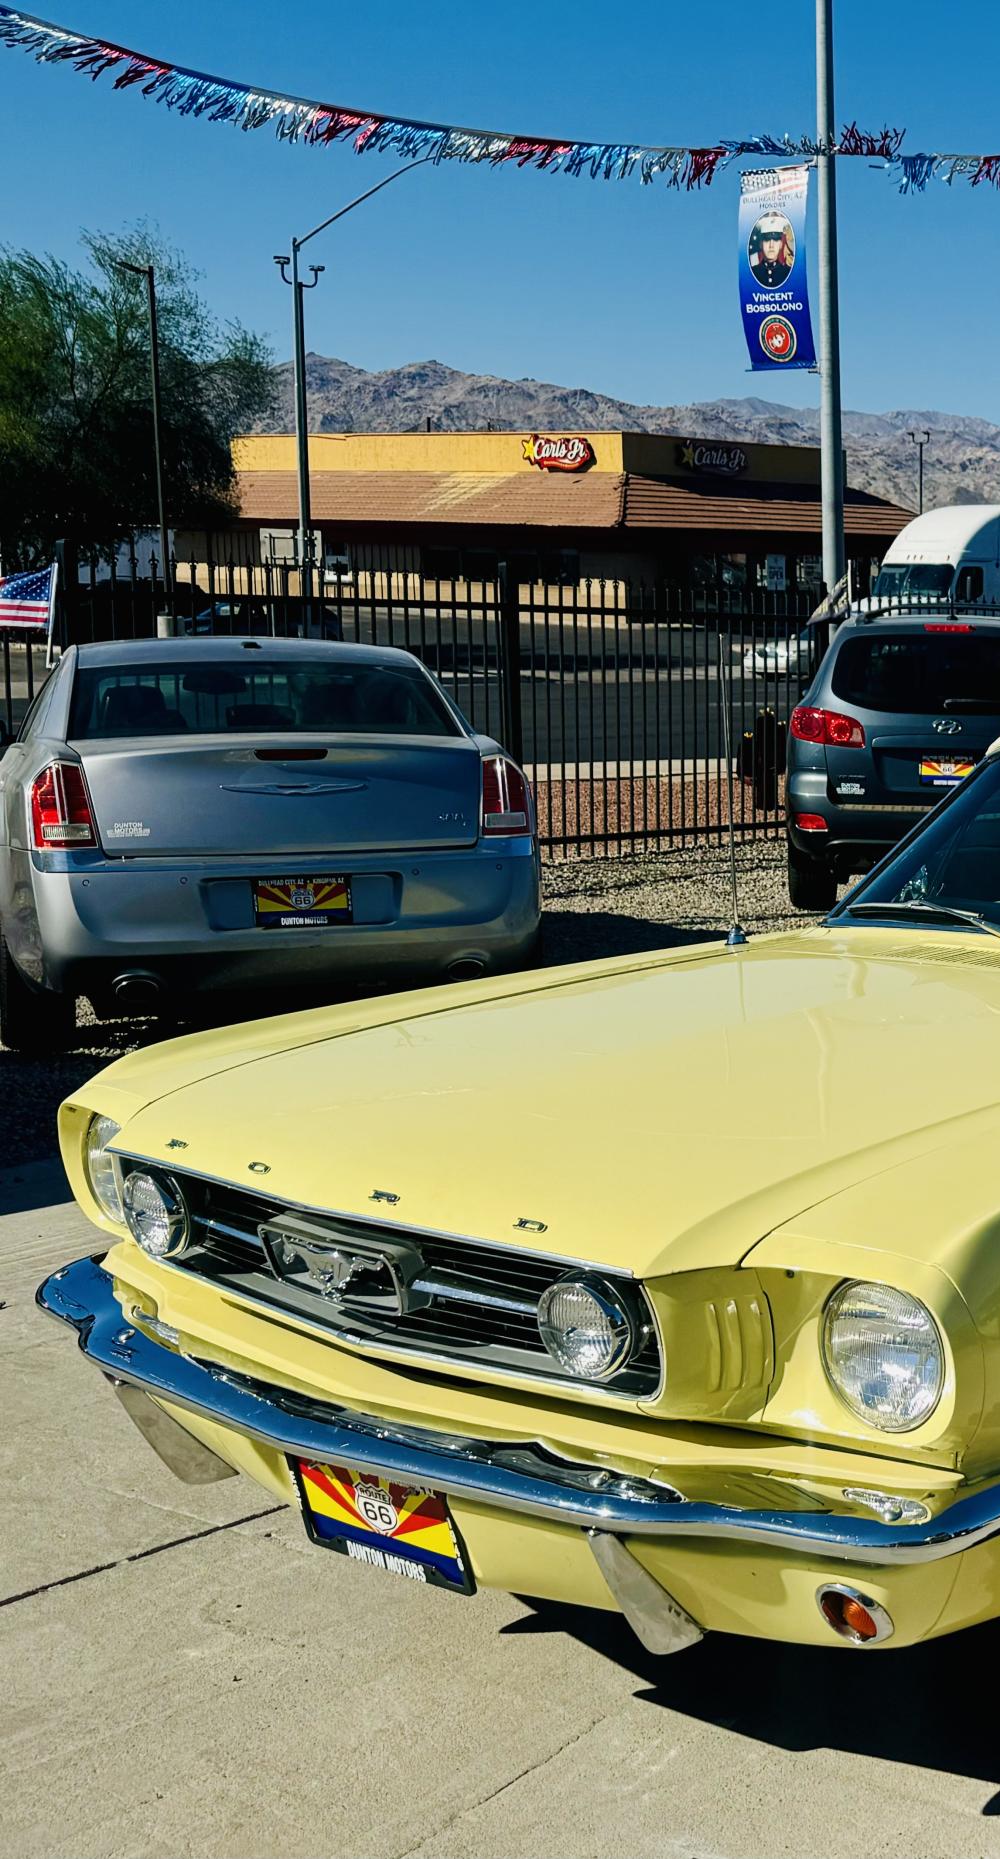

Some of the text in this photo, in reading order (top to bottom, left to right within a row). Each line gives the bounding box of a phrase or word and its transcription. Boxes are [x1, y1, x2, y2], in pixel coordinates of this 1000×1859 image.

[752, 292, 794, 302] VINCENT
[746, 302, 803, 313] BOSSOLONO
[295, 897, 311, 905] 66
[281, 916, 328, 926] DUNTON MOTORS
[359, 1487, 388, 1503] ROUTE
[363, 1501, 393, 1525] 66
[346, 1540, 427, 1583] DUNTON MOTORS
